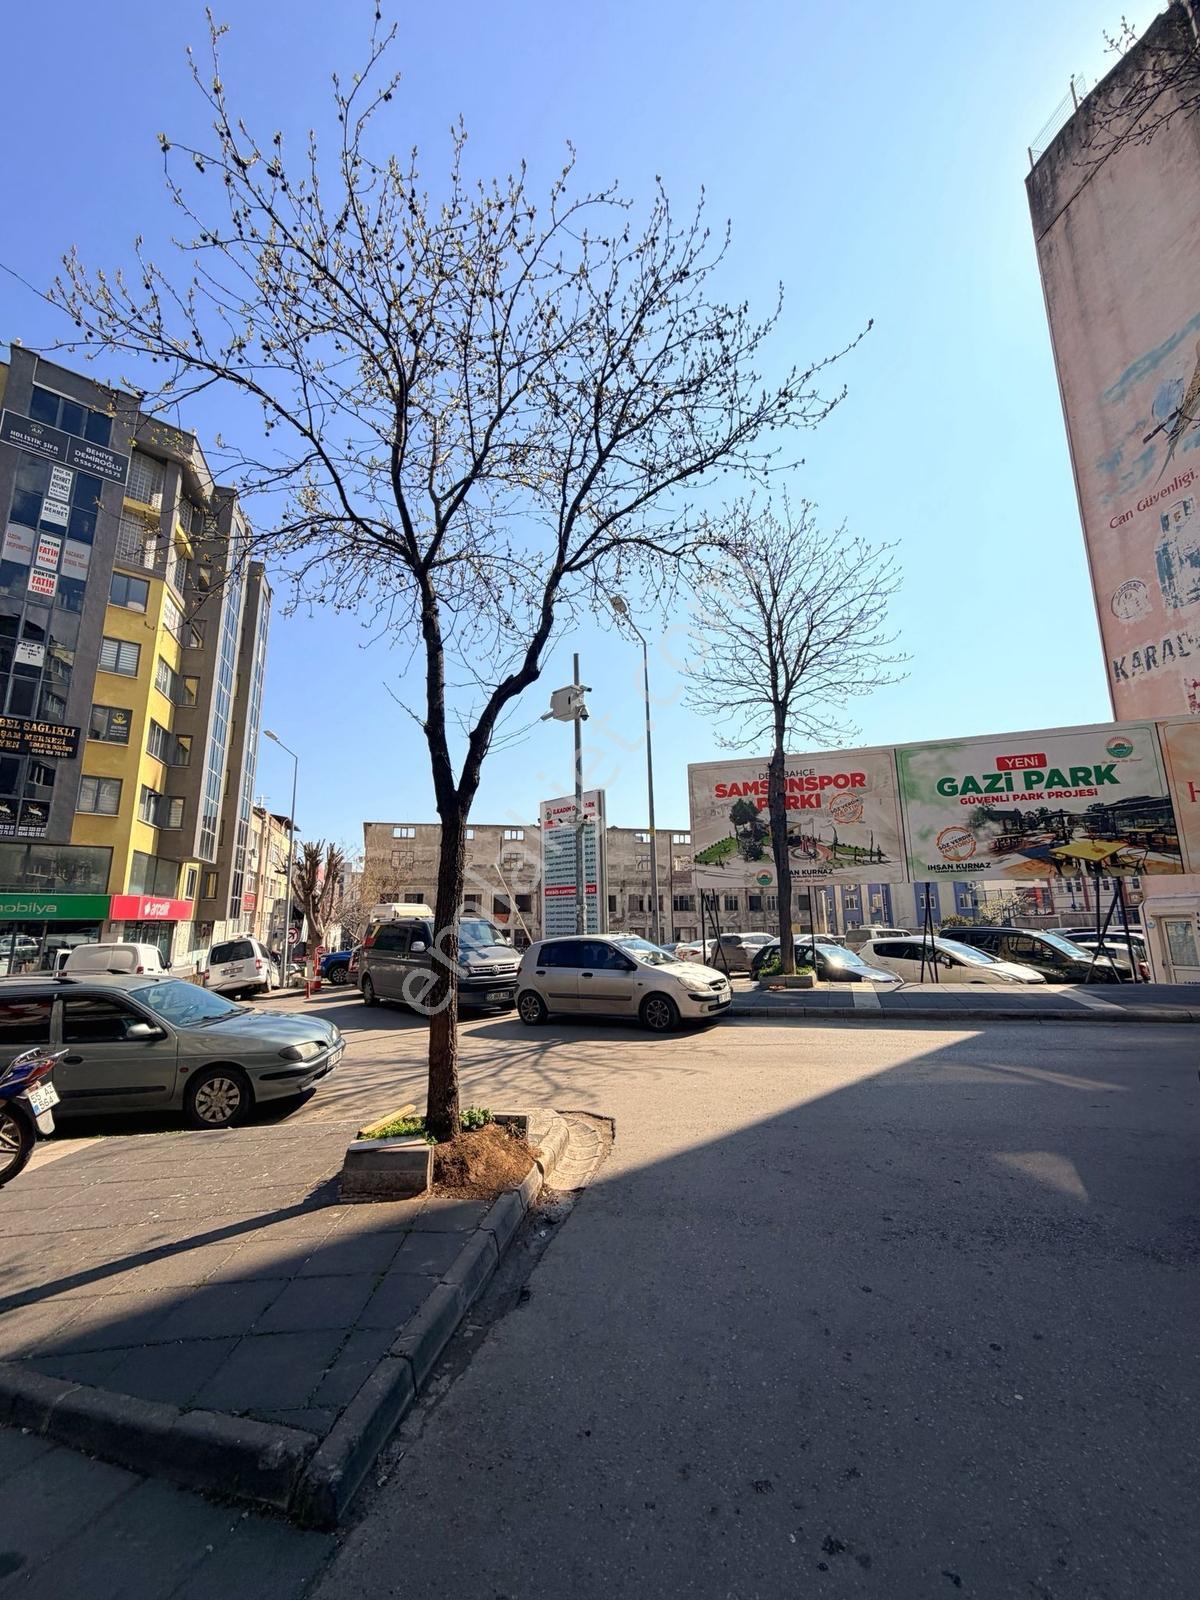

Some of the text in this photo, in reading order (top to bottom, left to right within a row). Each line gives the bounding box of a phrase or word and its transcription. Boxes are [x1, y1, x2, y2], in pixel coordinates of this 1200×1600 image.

[44, 506, 68, 518] MEHMET
[1109, 510, 1134, 529] Can
[39, 545, 59, 558] FATİH
[33, 569, 56, 580] DOKTOR
[31, 576, 55, 588] FATİH
[31, 584, 54, 595] YILMAZ
[23, 721, 76, 738] SAĞLIKLI
[24, 733, 67, 745] MERKEZİ
[758, 769, 815, 781] DEBAHÇE
[1023, 764, 1121, 791] PARK
[756, 793, 822, 812] PRKI
[1013, 792, 1044, 802] PARK
[955, 862, 991, 870] KURNAZ
[31, 1091, 42, 1104] 55
